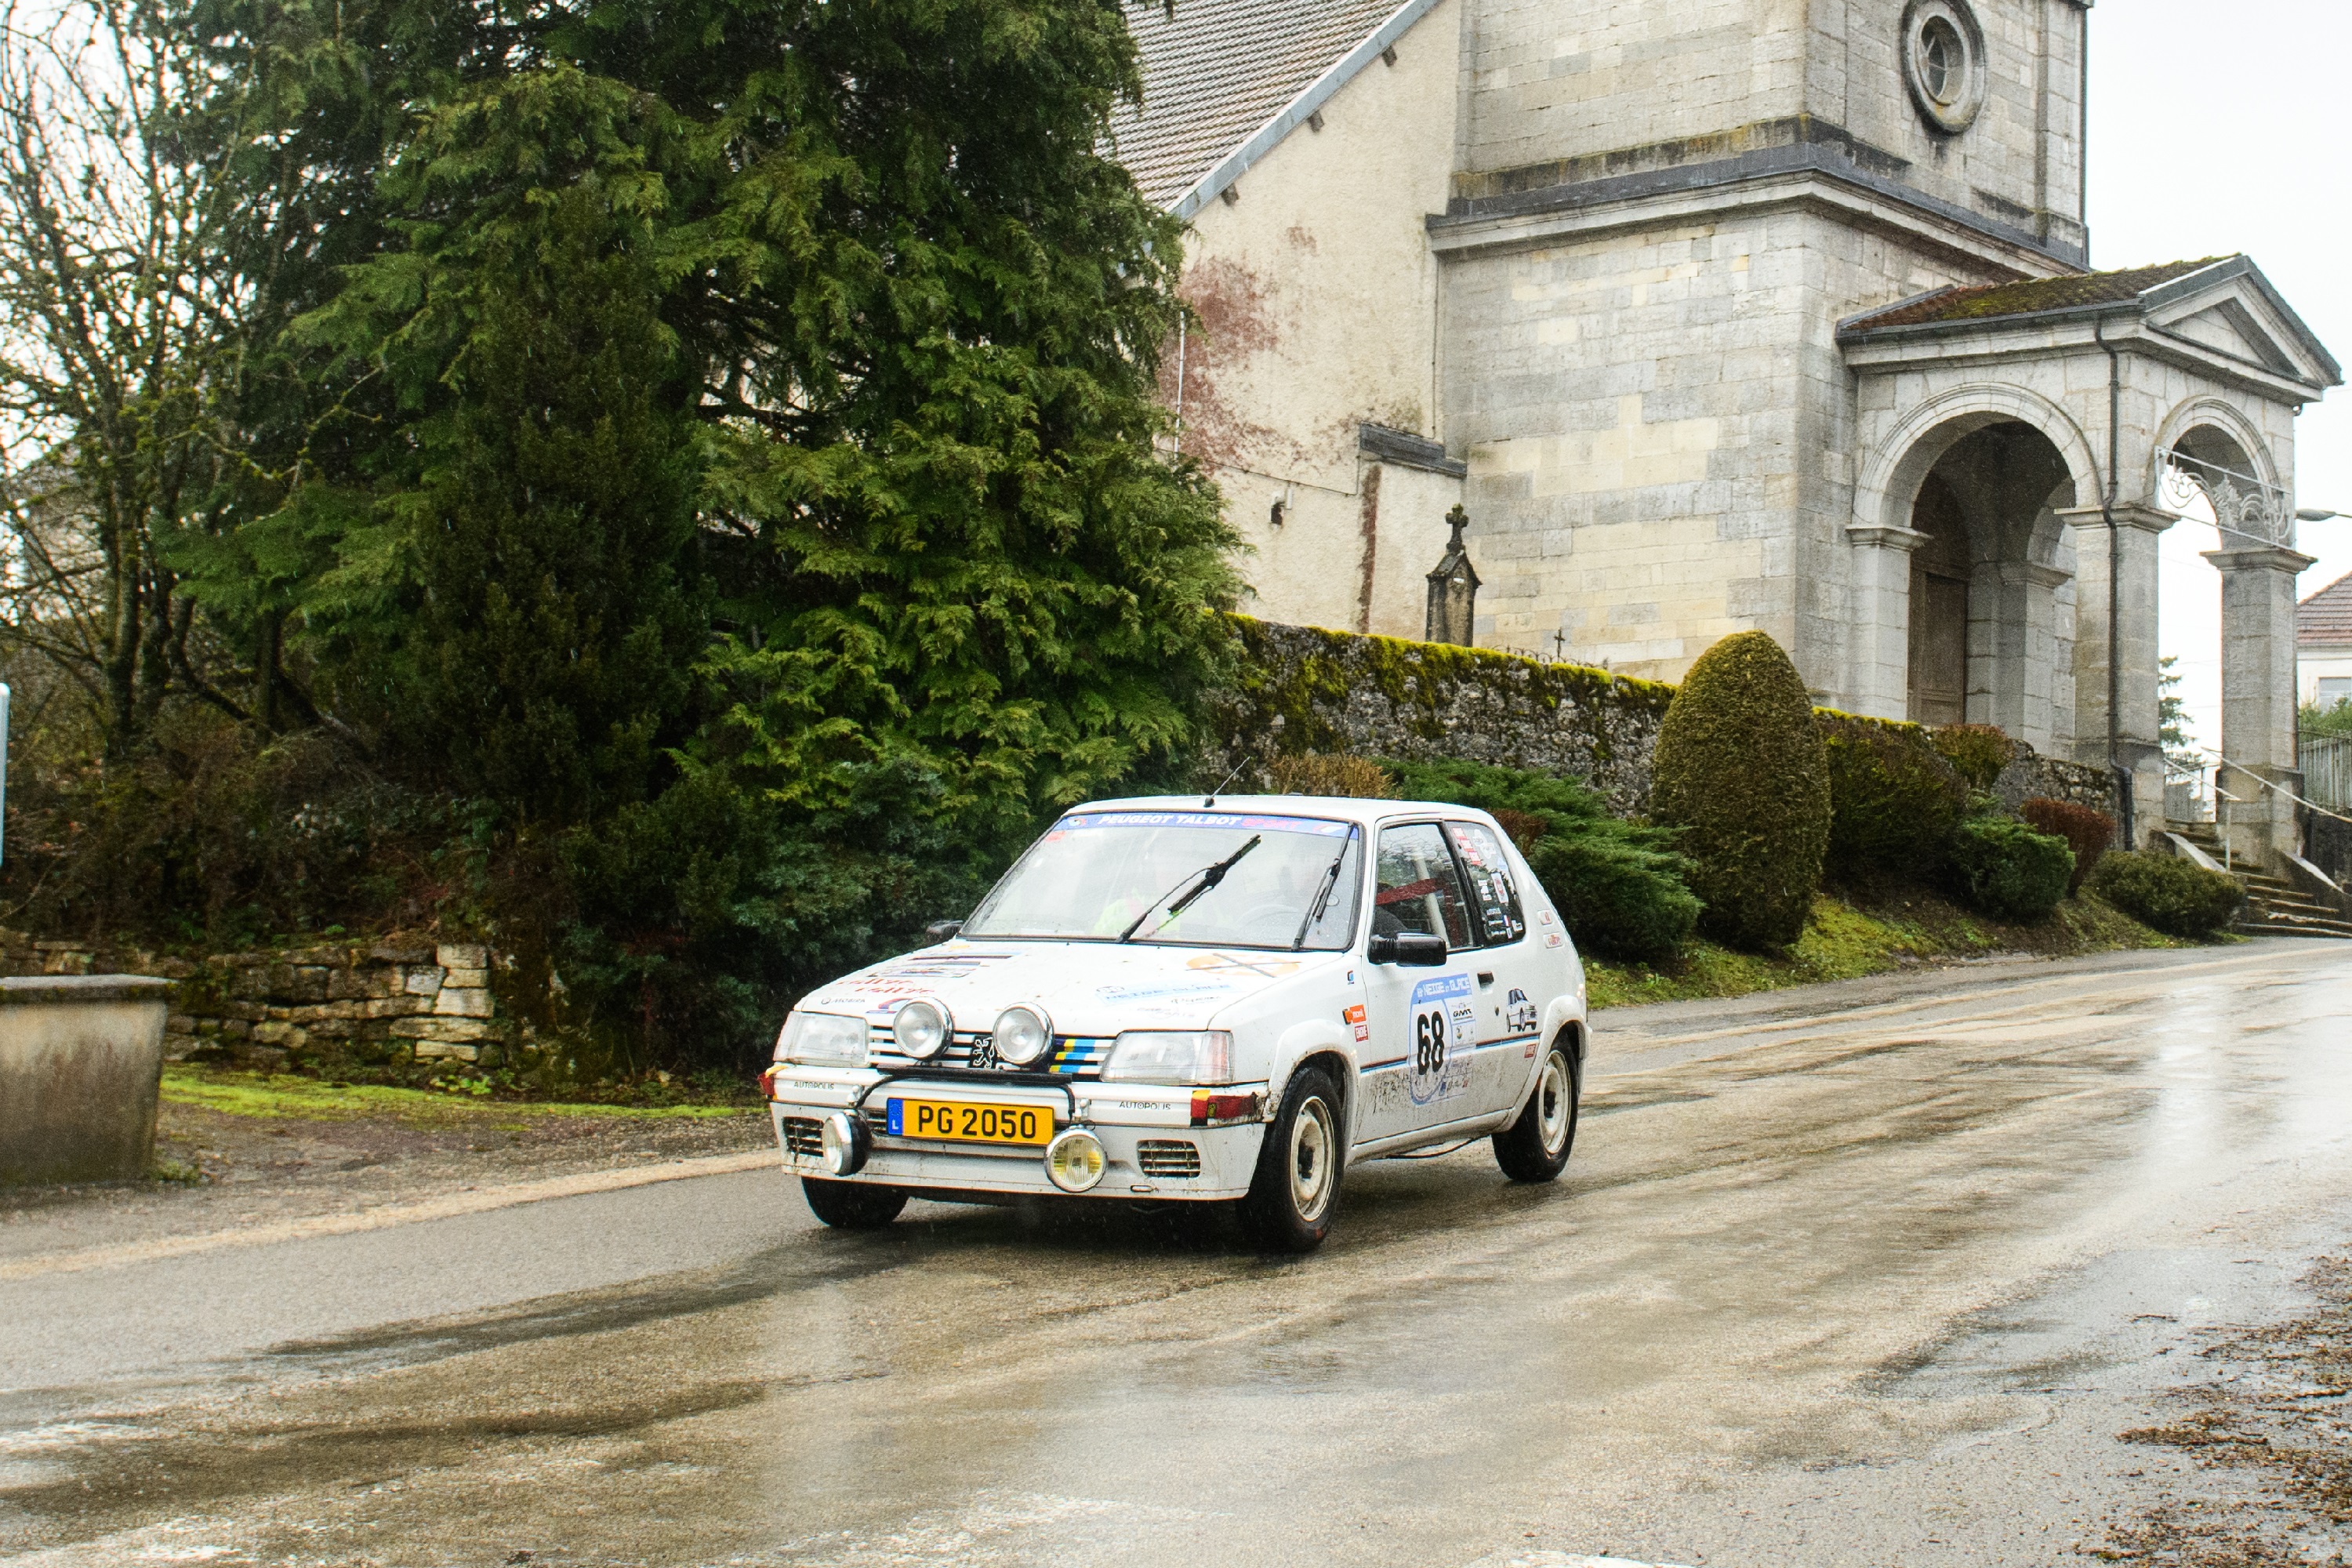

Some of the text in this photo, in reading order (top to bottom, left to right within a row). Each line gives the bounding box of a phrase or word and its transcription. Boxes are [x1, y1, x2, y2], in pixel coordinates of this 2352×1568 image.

[1098, 815, 1174, 825] PEUGEOT
[1176, 815, 1242, 826] TALBOT
[1417, 1011, 1444, 1075] 68
[793, 1081, 835, 1091] AUTOPOLIS
[1119, 1101, 1171, 1110] AUTOPOLIS
[891, 1119, 899, 1130] L
[918, 1105, 1036, 1139] PG 2050
